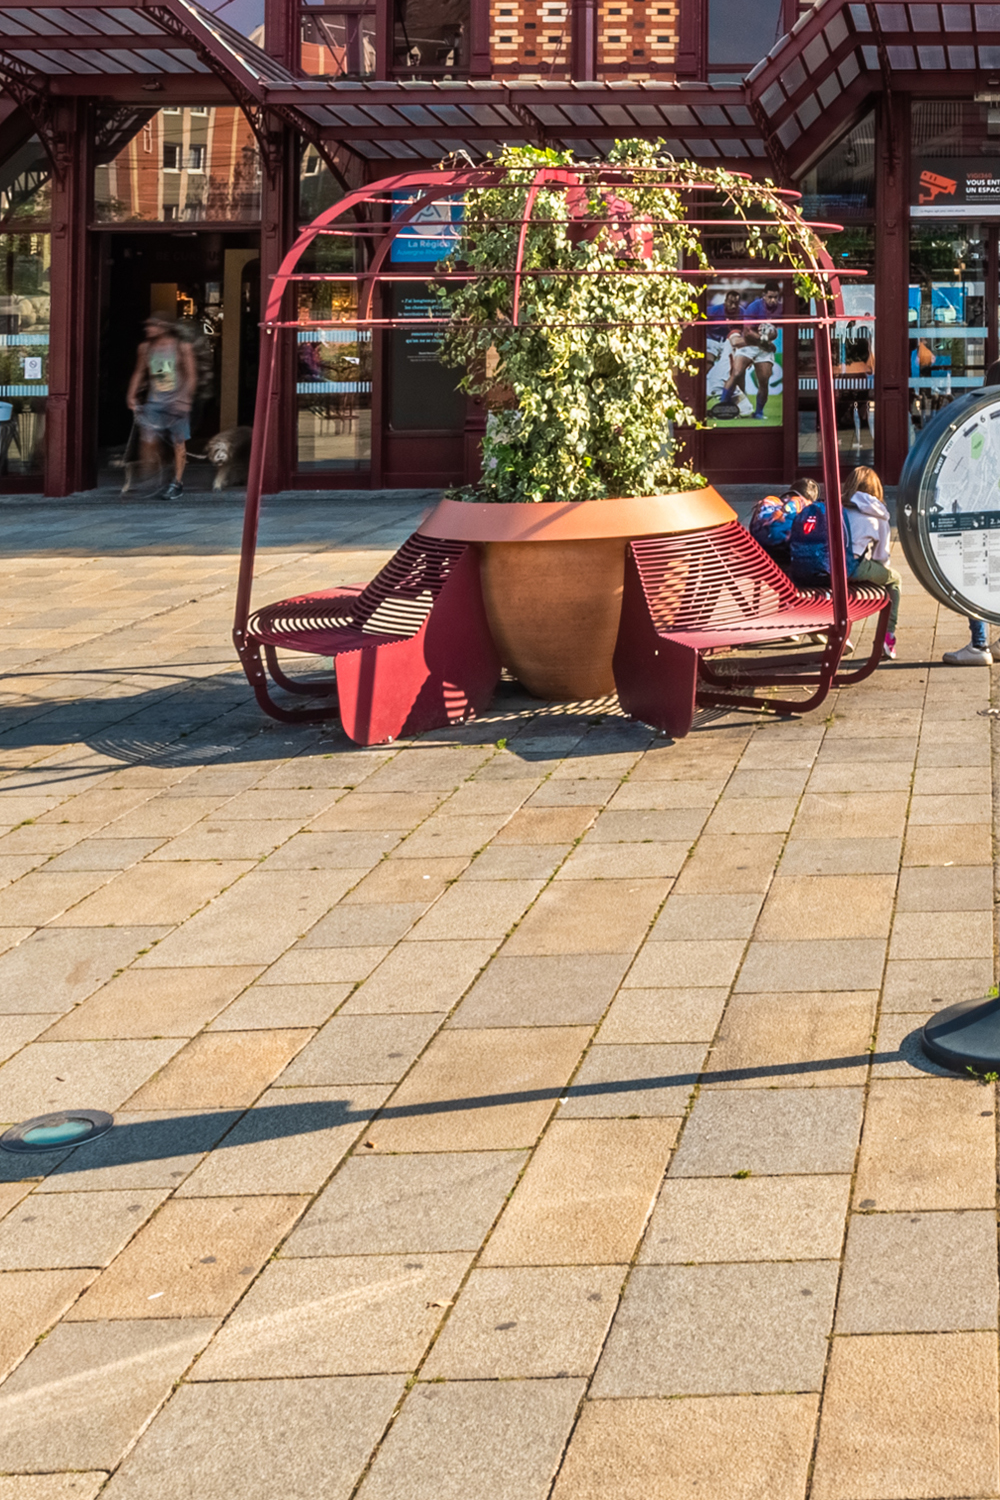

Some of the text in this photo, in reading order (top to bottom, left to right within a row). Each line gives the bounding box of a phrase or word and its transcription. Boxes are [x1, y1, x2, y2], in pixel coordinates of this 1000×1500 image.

[966, 186, 977, 194] UN
[980, 414, 986, 423] 6
[933, 456, 944, 474] OUEST
